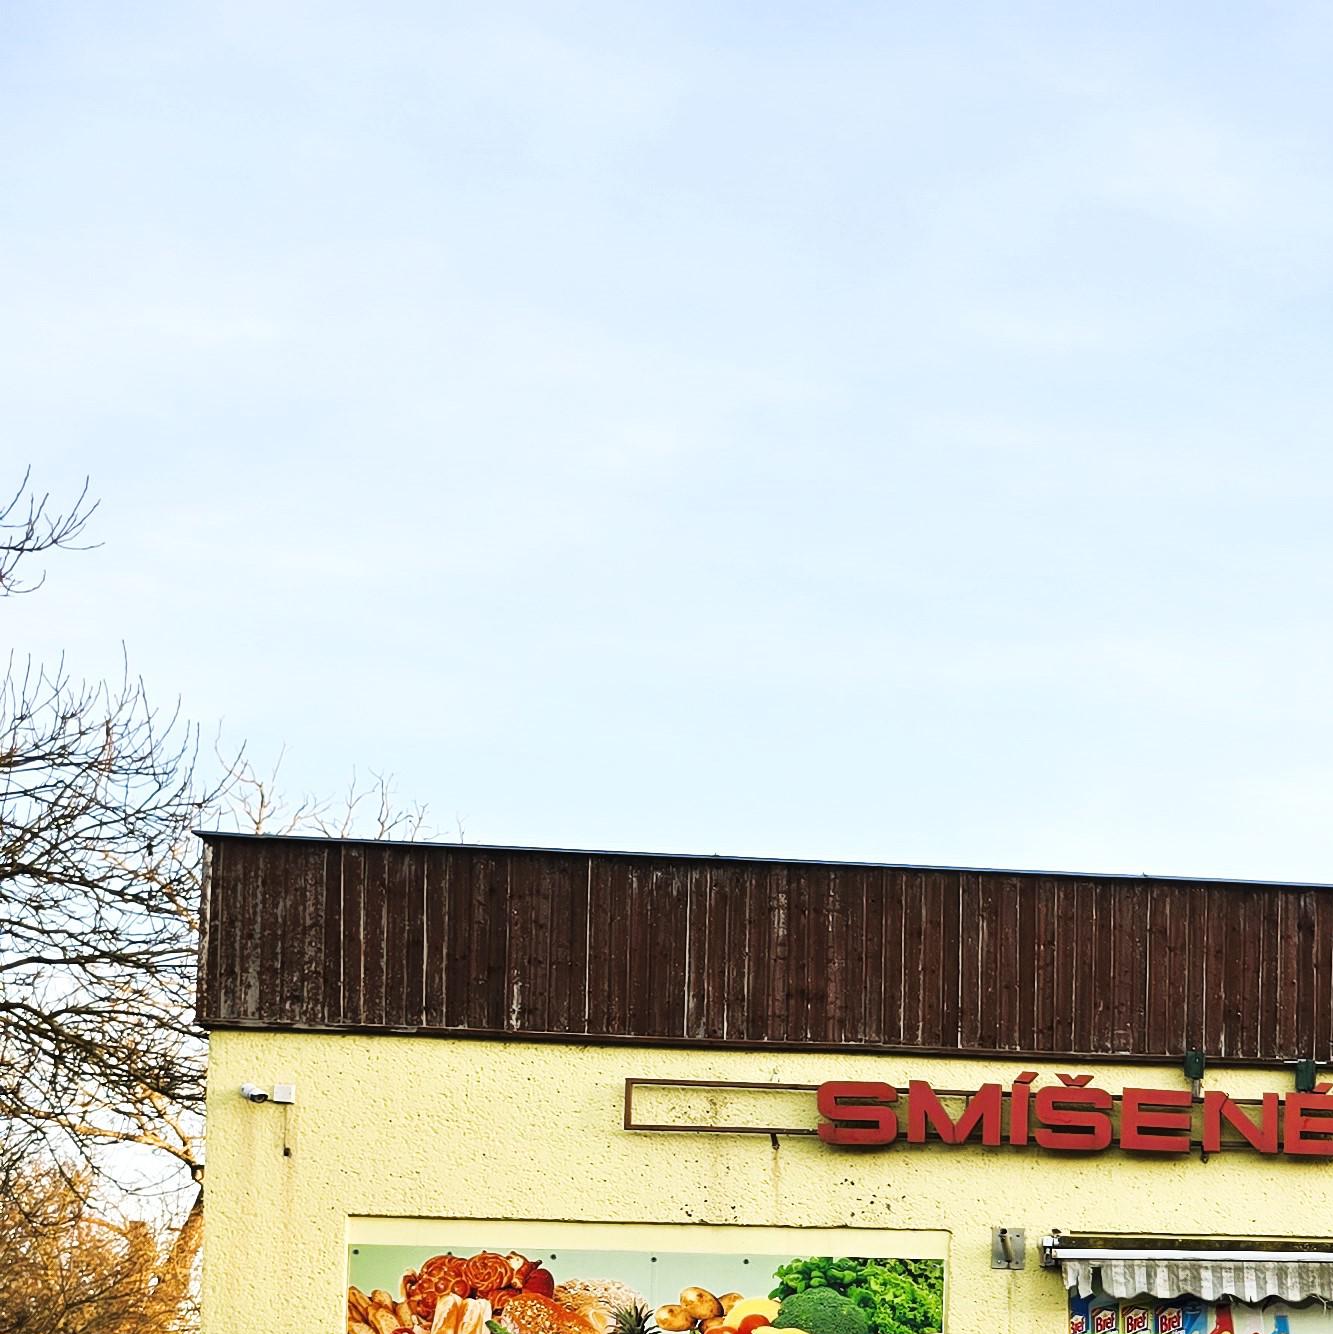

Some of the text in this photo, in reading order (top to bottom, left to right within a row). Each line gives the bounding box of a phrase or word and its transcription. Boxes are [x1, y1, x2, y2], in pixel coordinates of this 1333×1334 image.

[1095, 1313, 1115, 1332] Bref
[1126, 1312, 1148, 1332] Bref
[1159, 1312, 1183, 1331] Bref
